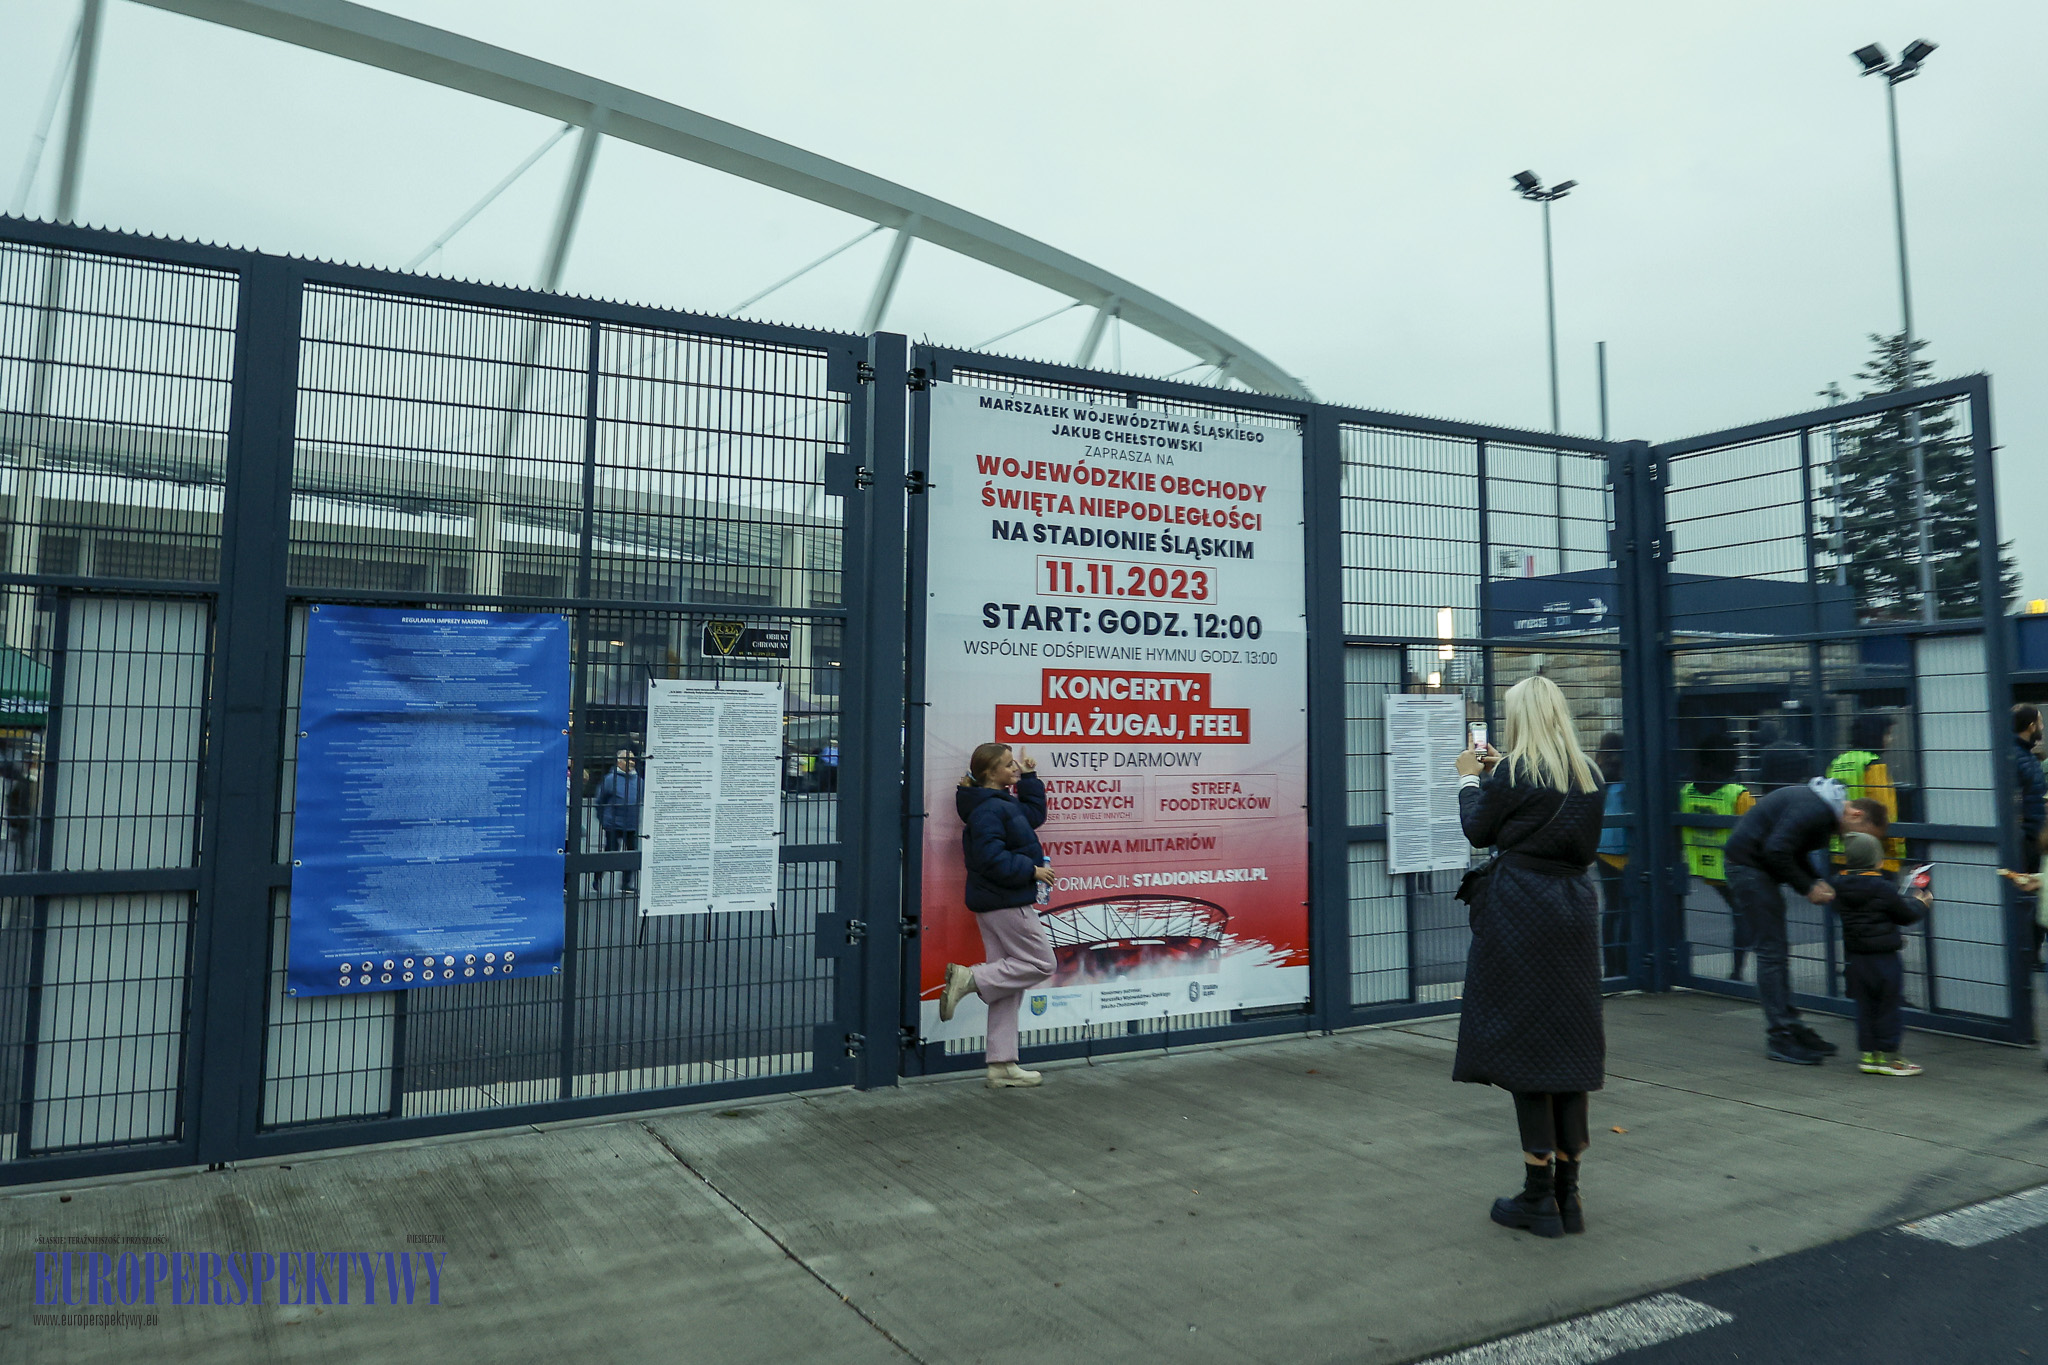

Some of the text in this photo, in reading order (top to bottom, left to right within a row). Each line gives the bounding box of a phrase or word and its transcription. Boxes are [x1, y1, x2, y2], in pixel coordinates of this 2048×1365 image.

[980, 396, 1264, 443] MARSZAŁEK WOJEWÓDZTWA ŚLĄSKIEGO
[1051, 423, 1202, 453] JAKUB CHEŁSTOWSKI
[1085, 445, 1174, 466] ZAPRASZA NA
[976, 454, 1267, 503] WOJEWÓDZKIE OBCHODY
[981, 480, 1262, 531] ŚWIĘTA NIEPODLEGŁOŚCI
[992, 519, 1254, 560] NA STADIONIE ŚLĄSKIM
[1045, 560, 1209, 601] 11.11.2023
[982, 603, 1263, 640] START: GODZ. 12:00
[964, 637, 1278, 665] WSPÓLNE ODŚPIEWANIE HYMNU GODZ. 13:00
[1049, 675, 1201, 702] KONCERTY:
[1004, 706, 1243, 740] JULIA ŻUGAJ, FEEL
[1052, 751, 1202, 771] WSTĘP DARMOWY
[1045, 780, 1121, 794] ATRAKCJI
[1191, 781, 1242, 795] STREFA
[1046, 796, 1135, 811] MŁODSZYCH
[1160, 792, 1271, 811] FOODTRUCKÓW
[1126, 832, 1216, 854] MILITARIÓW
[1133, 868, 1268, 888] STADIONSLASKI.PL
